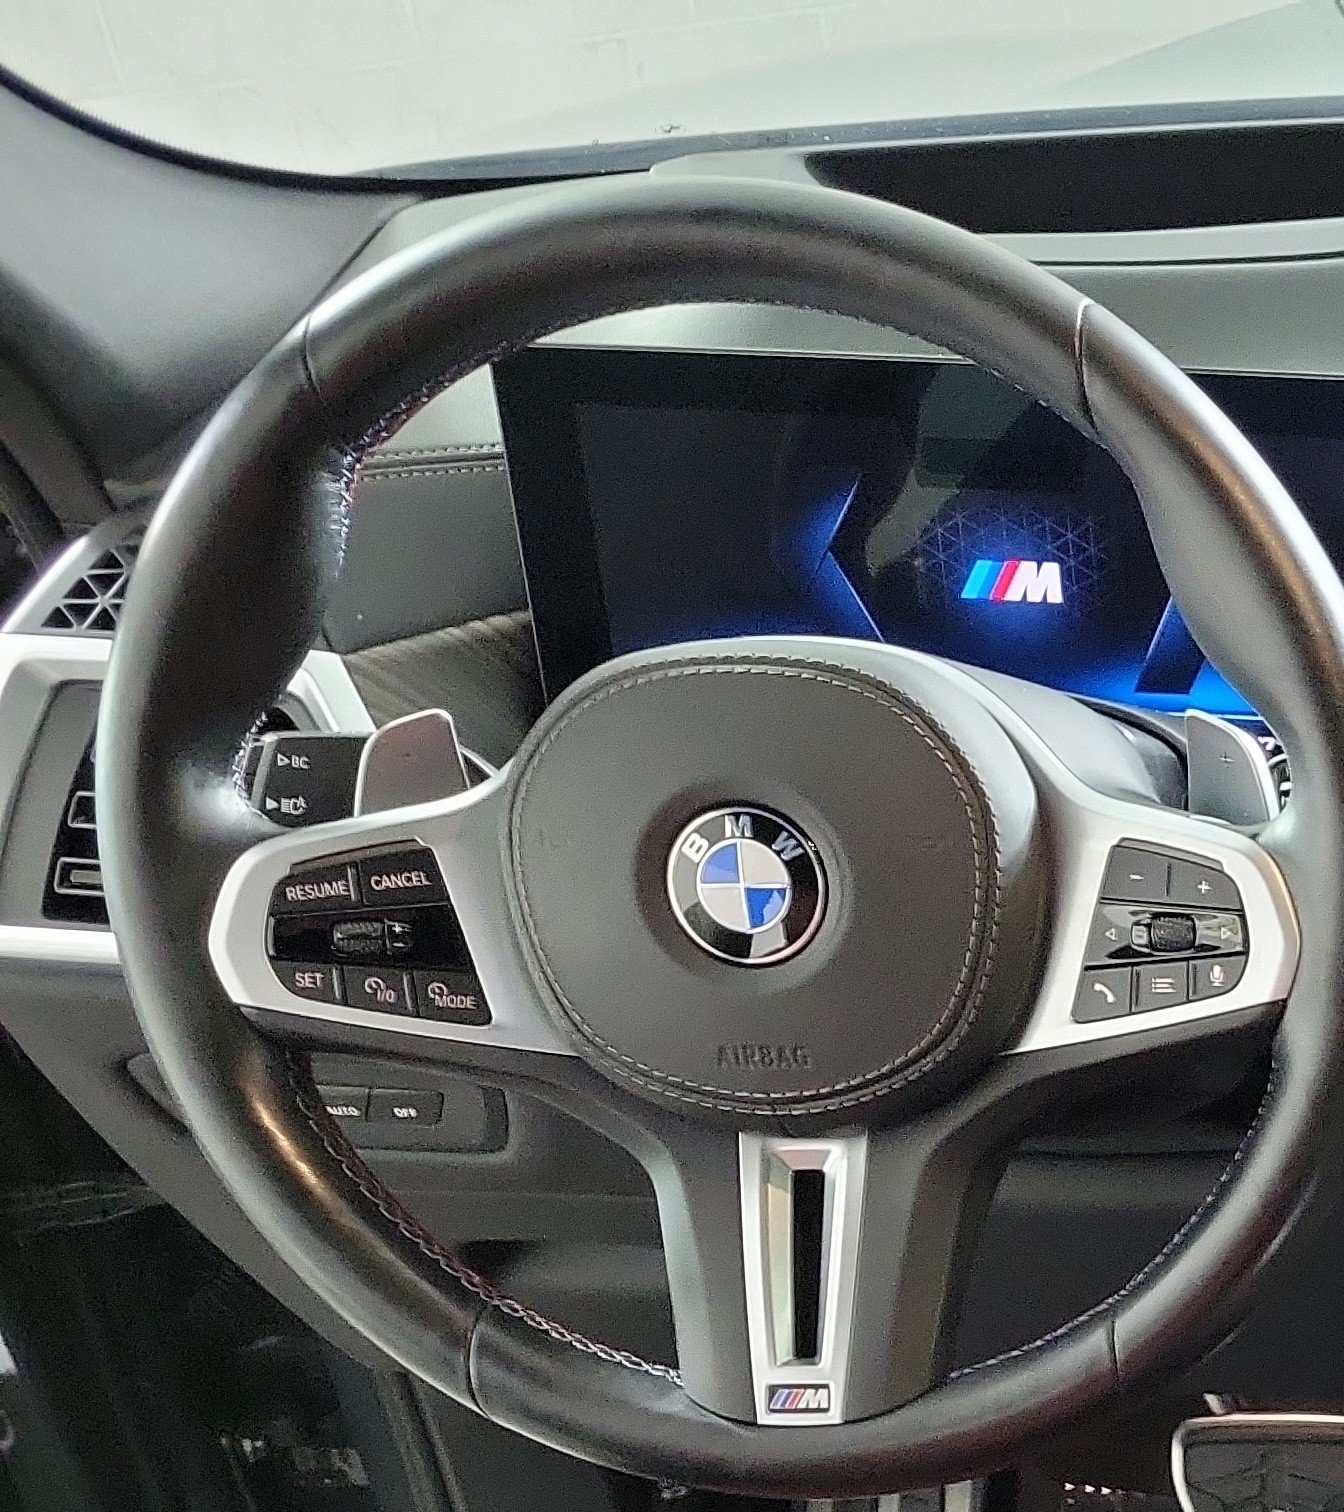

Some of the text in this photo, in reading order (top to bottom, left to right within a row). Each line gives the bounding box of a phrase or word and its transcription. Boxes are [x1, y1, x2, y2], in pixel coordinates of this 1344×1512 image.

[682, 814, 805, 863] BMW
[285, 879, 350, 902] RESUME
[370, 870, 432, 891] CANCEL
[295, 972, 324, 988] SET
[434, 995, 478, 1010] MODE
[716, 1041, 812, 1070] AIRBAG
[393, 1107, 417, 1118] OFF
